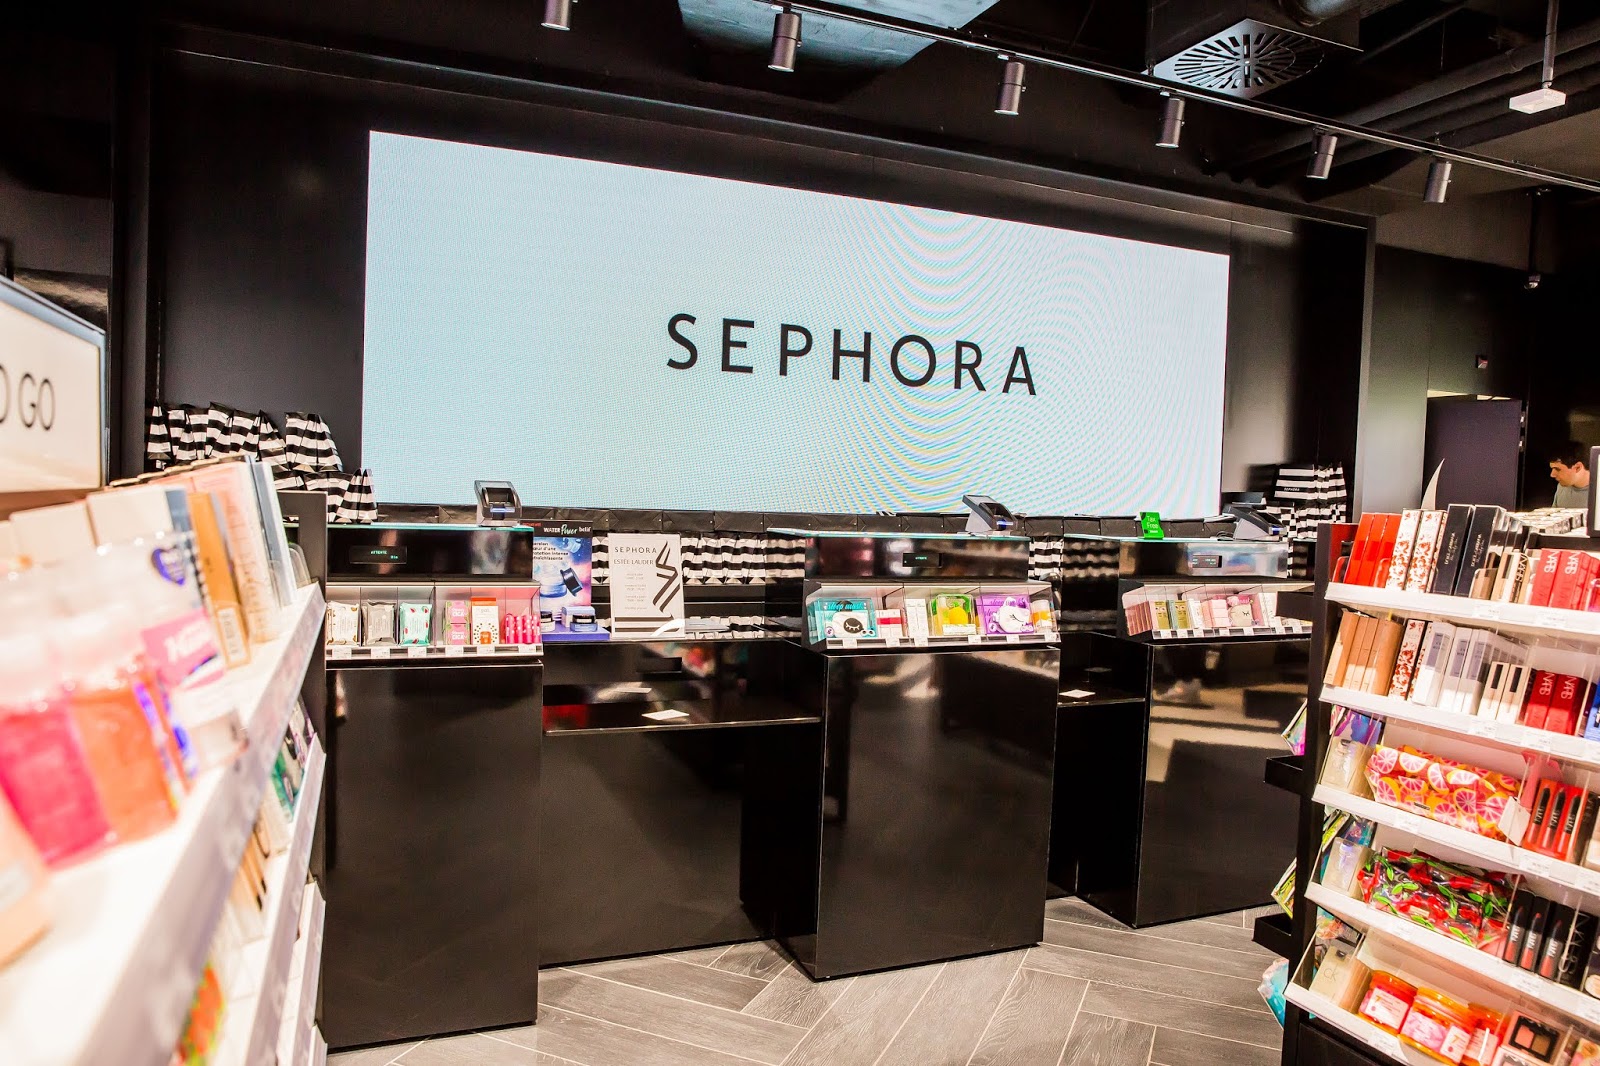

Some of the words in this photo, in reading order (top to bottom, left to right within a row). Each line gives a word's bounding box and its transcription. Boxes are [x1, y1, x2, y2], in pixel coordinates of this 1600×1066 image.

[666, 312, 1037, 396] SEPHORA
[17, 372, 56, 431] GO
[614, 546, 657, 554] SEPHORA
[1564, 551, 1581, 575] NARS
[1538, 672, 1556, 696] NARS
[1560, 675, 1577, 700] NARS
